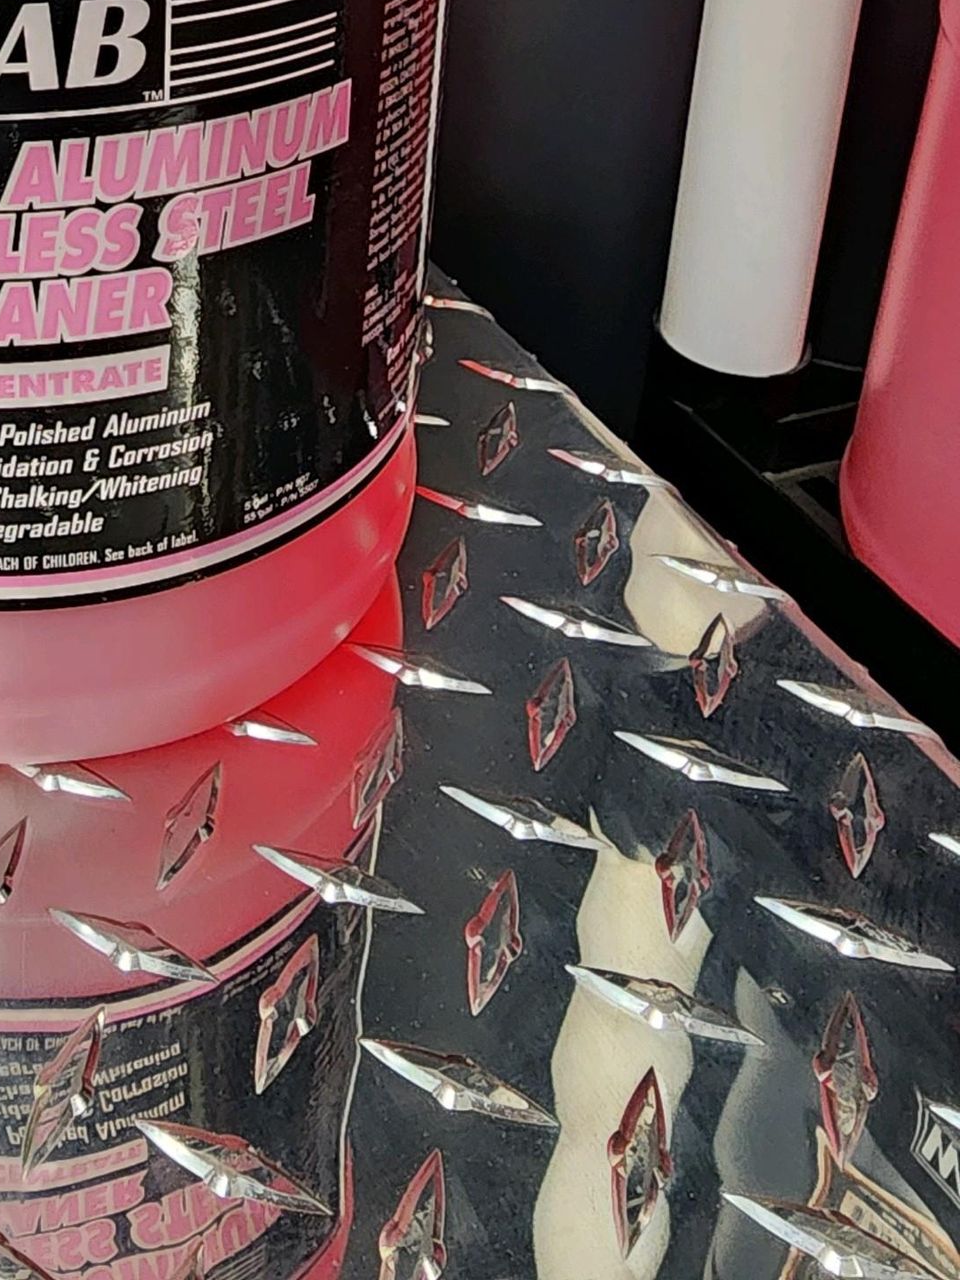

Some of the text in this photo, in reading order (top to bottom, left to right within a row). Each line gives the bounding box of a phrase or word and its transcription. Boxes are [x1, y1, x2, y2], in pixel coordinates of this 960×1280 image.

[142, 91, 164, 100] TM
[153, 162, 316, 263] STEEL
[103, 401, 212, 438] Aluminum
[83, 448, 100, 472] &
[108, 430, 214, 469] Corrosion
[23, 555, 39, 570] OF
[42, 549, 101, 570] CHILDREN.
[105, 547, 125, 563] See
[128, 539, 153, 559] back
[157, 536, 168, 552] of
